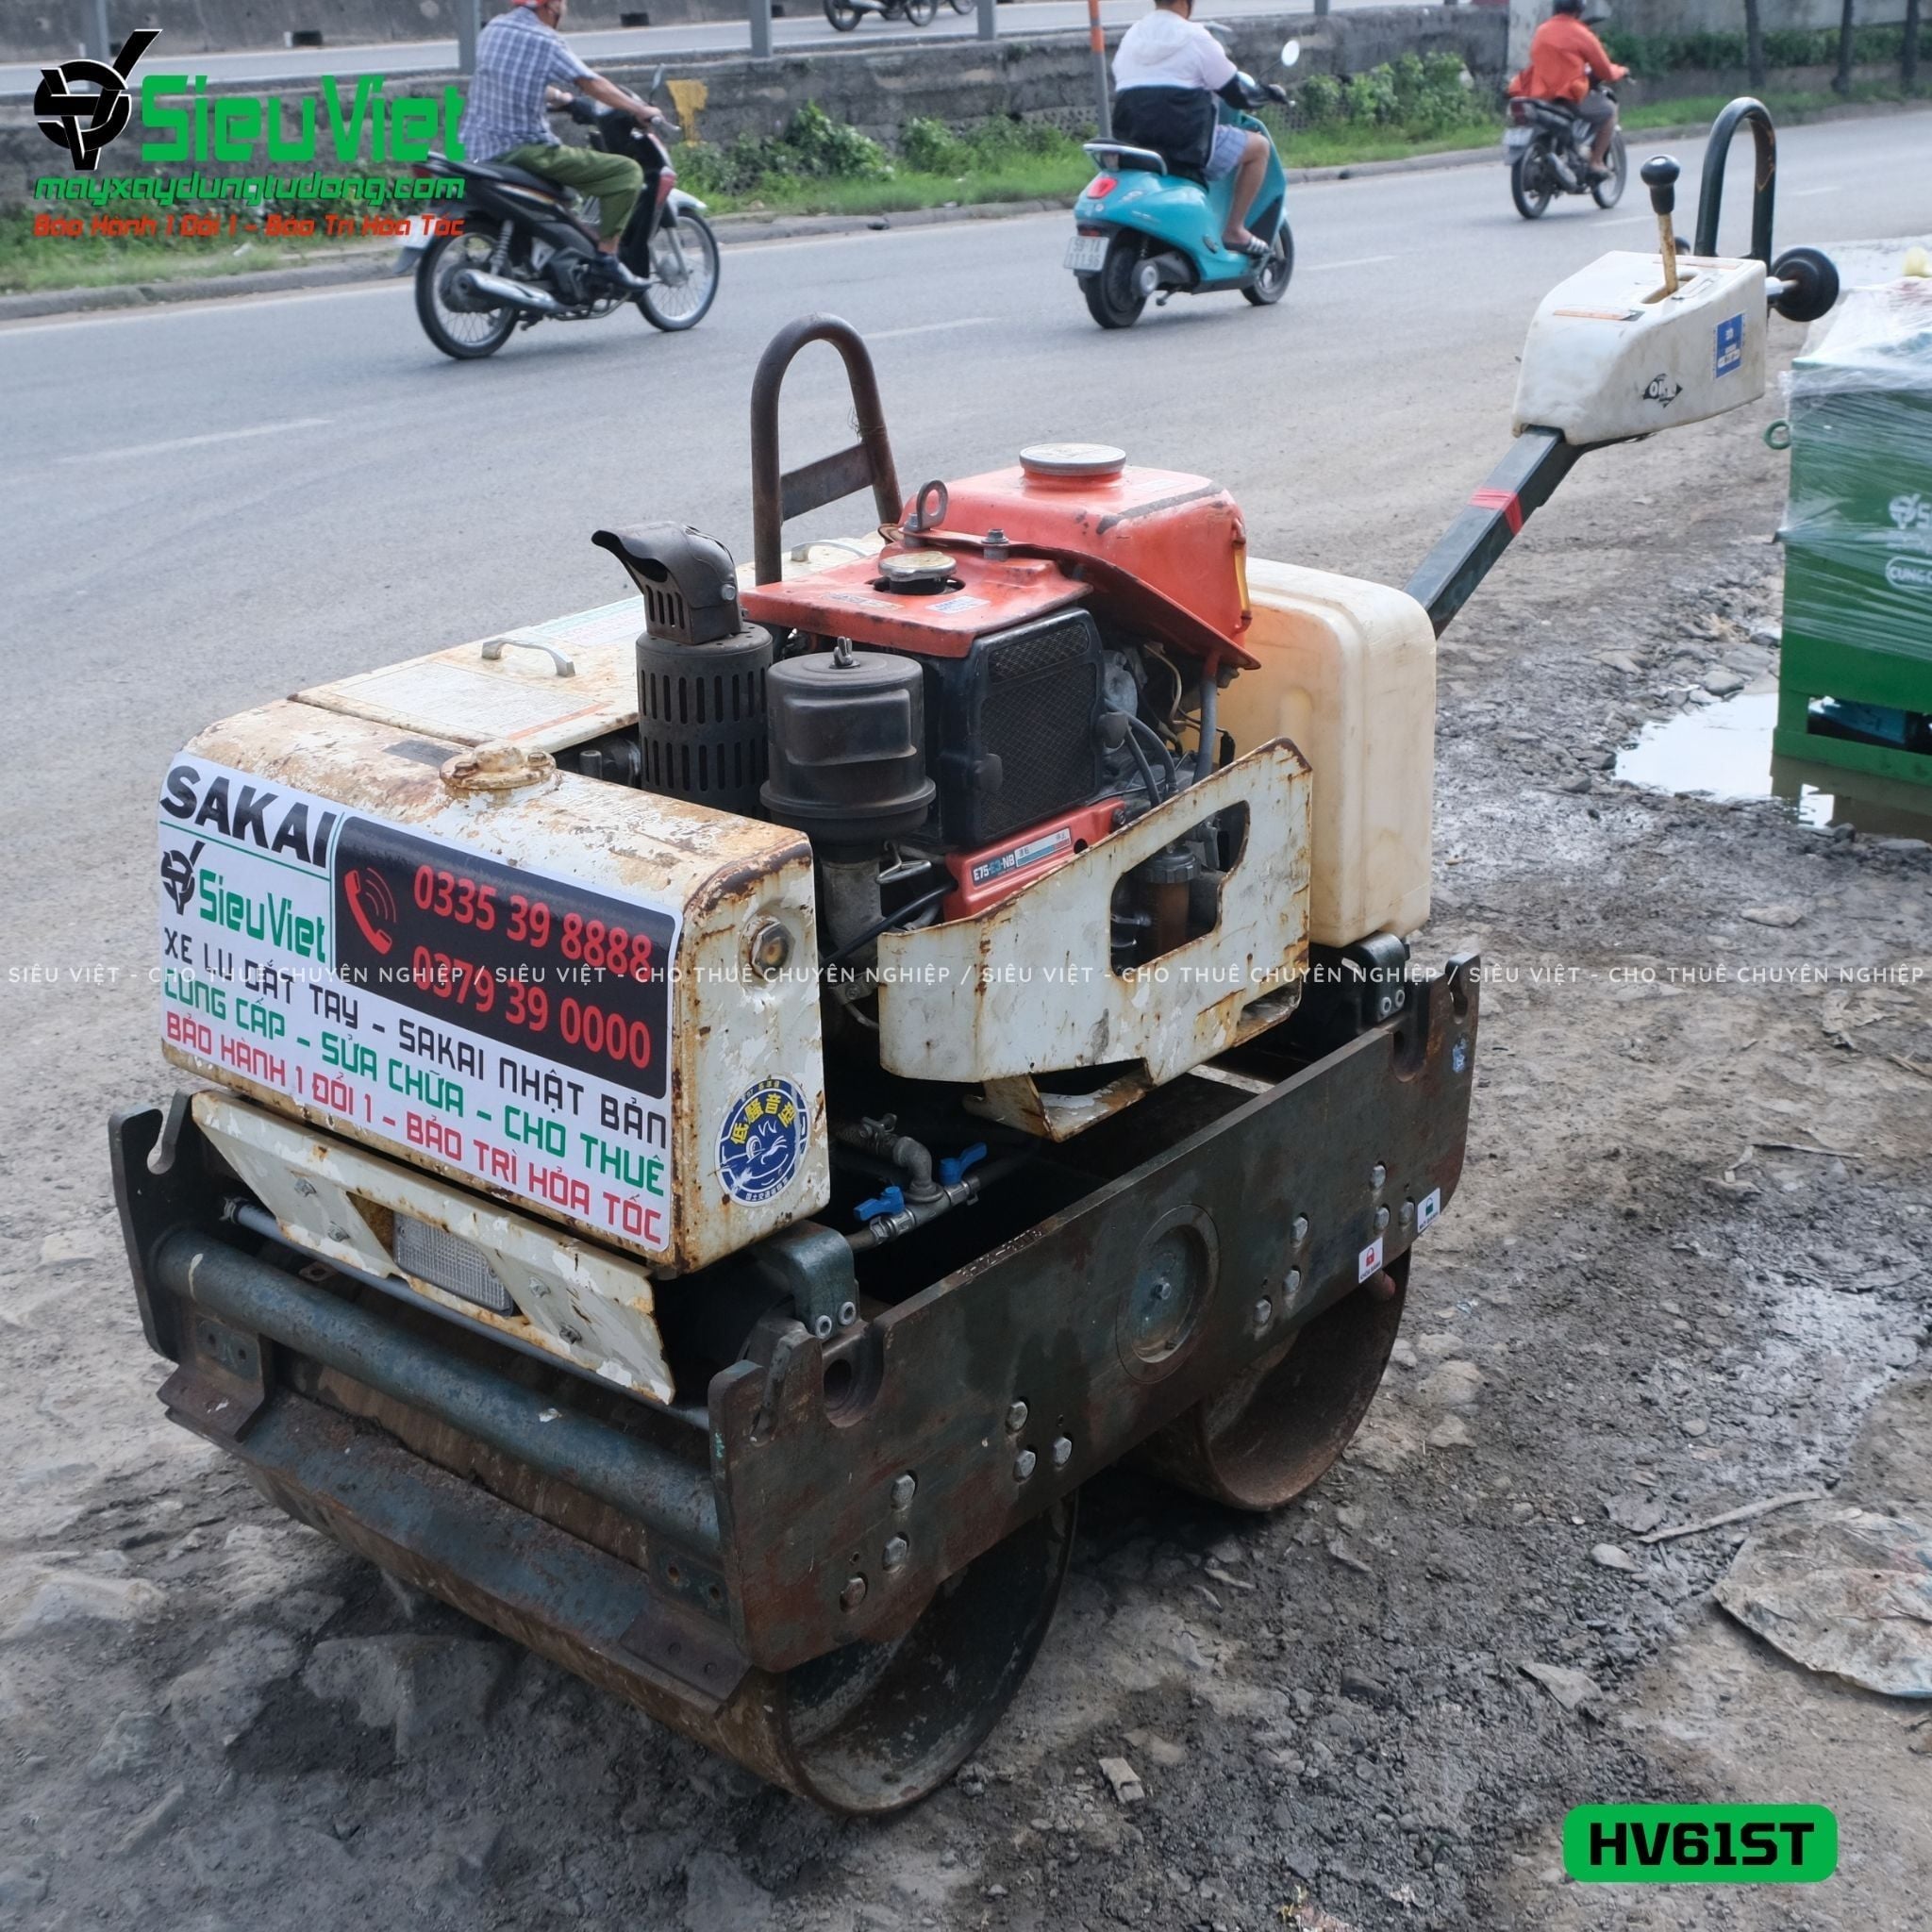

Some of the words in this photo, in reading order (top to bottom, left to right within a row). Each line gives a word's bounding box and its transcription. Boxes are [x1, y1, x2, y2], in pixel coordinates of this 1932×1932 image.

[159, 765, 338, 869] SAKAI
[199, 868, 326, 964] SieuViet
[413, 864, 497, 931] 0335
[507, 894, 551, 948] 39
[560, 912, 653, 984] 8888
[164, 926, 192, 965] XE
[308, 983, 358, 1029] TAY
[372, 1023, 386, 1034] -
[399, 1018, 484, 1081] SAKAI
[499, 1057, 585, 1116] NHẬT
[600, 1093, 667, 1150] BẢN
[412, 945, 495, 1013] 0379
[505, 977, 549, 1032] 39
[559, 997, 651, 1070] 0000
[164, 969, 226, 1021] CUNG
[236, 996, 285, 1041] CẤP
[296, 1037, 311, 1048] -
[322, 1030, 377, 1083] SỬA
[388, 1058, 464, 1119] CHỮA
[476, 1109, 492, 1122] -
[504, 1105, 566, 1158] CHO
[580, 1132, 665, 1197] THUÊ
[166, 1010, 212, 1056] BẢO
[221, 1034, 286, 1088] HÀNH
[295, 1065, 303, 1095] 1
[312, 1071, 354, 1116] ĐỔI
[364, 1092, 372, 1124] 1
[407, 1110, 462, 1162] BẢO
[473, 1139, 518, 1186] TRÌ
[528, 1161, 591, 1216] HỎA
[602, 1191, 661, 1245] TỐC
